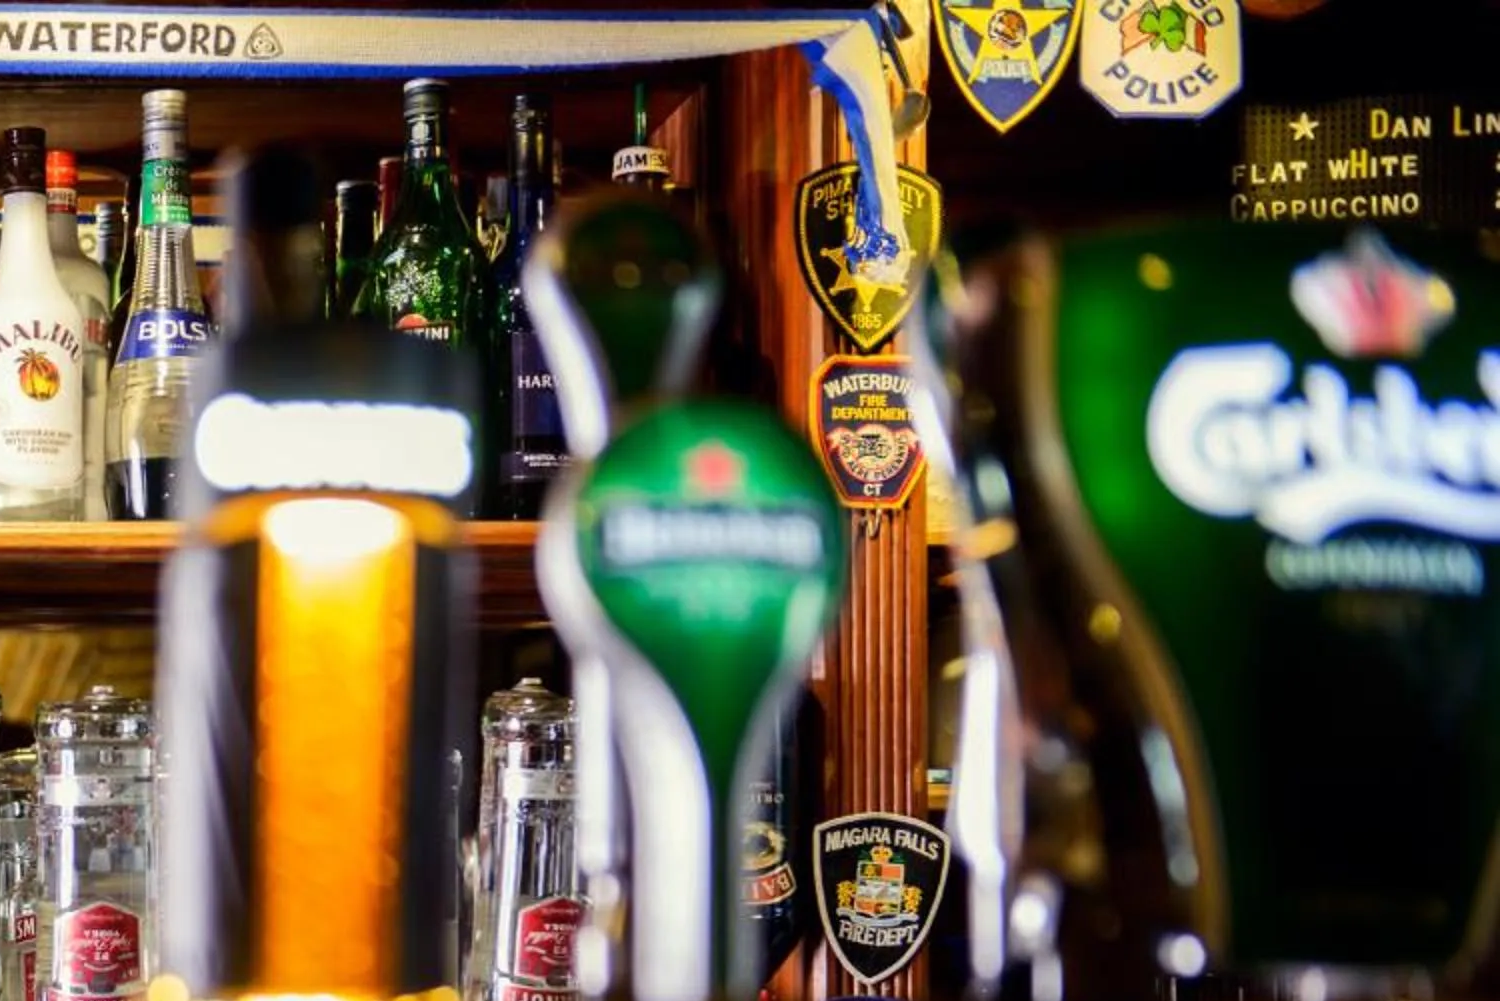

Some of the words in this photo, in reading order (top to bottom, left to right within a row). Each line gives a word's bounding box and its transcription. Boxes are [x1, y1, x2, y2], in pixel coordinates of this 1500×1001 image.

[1103, 60, 1218, 105] POLICE
[1232, 160, 1308, 186] FLAT
[138, 320, 207, 342] BOLS
[414, 326, 450, 341] TINI
[824, 373, 916, 399] WATERBUR
[859, 394, 888, 408] FIRE
[831, 407, 914, 421] DEPARTMENT
[863, 483, 884, 496] CT
[826, 826, 891, 853] NIAGARA
[895, 829, 939, 860] FALLS
[838, 919, 876, 945] FIRE
